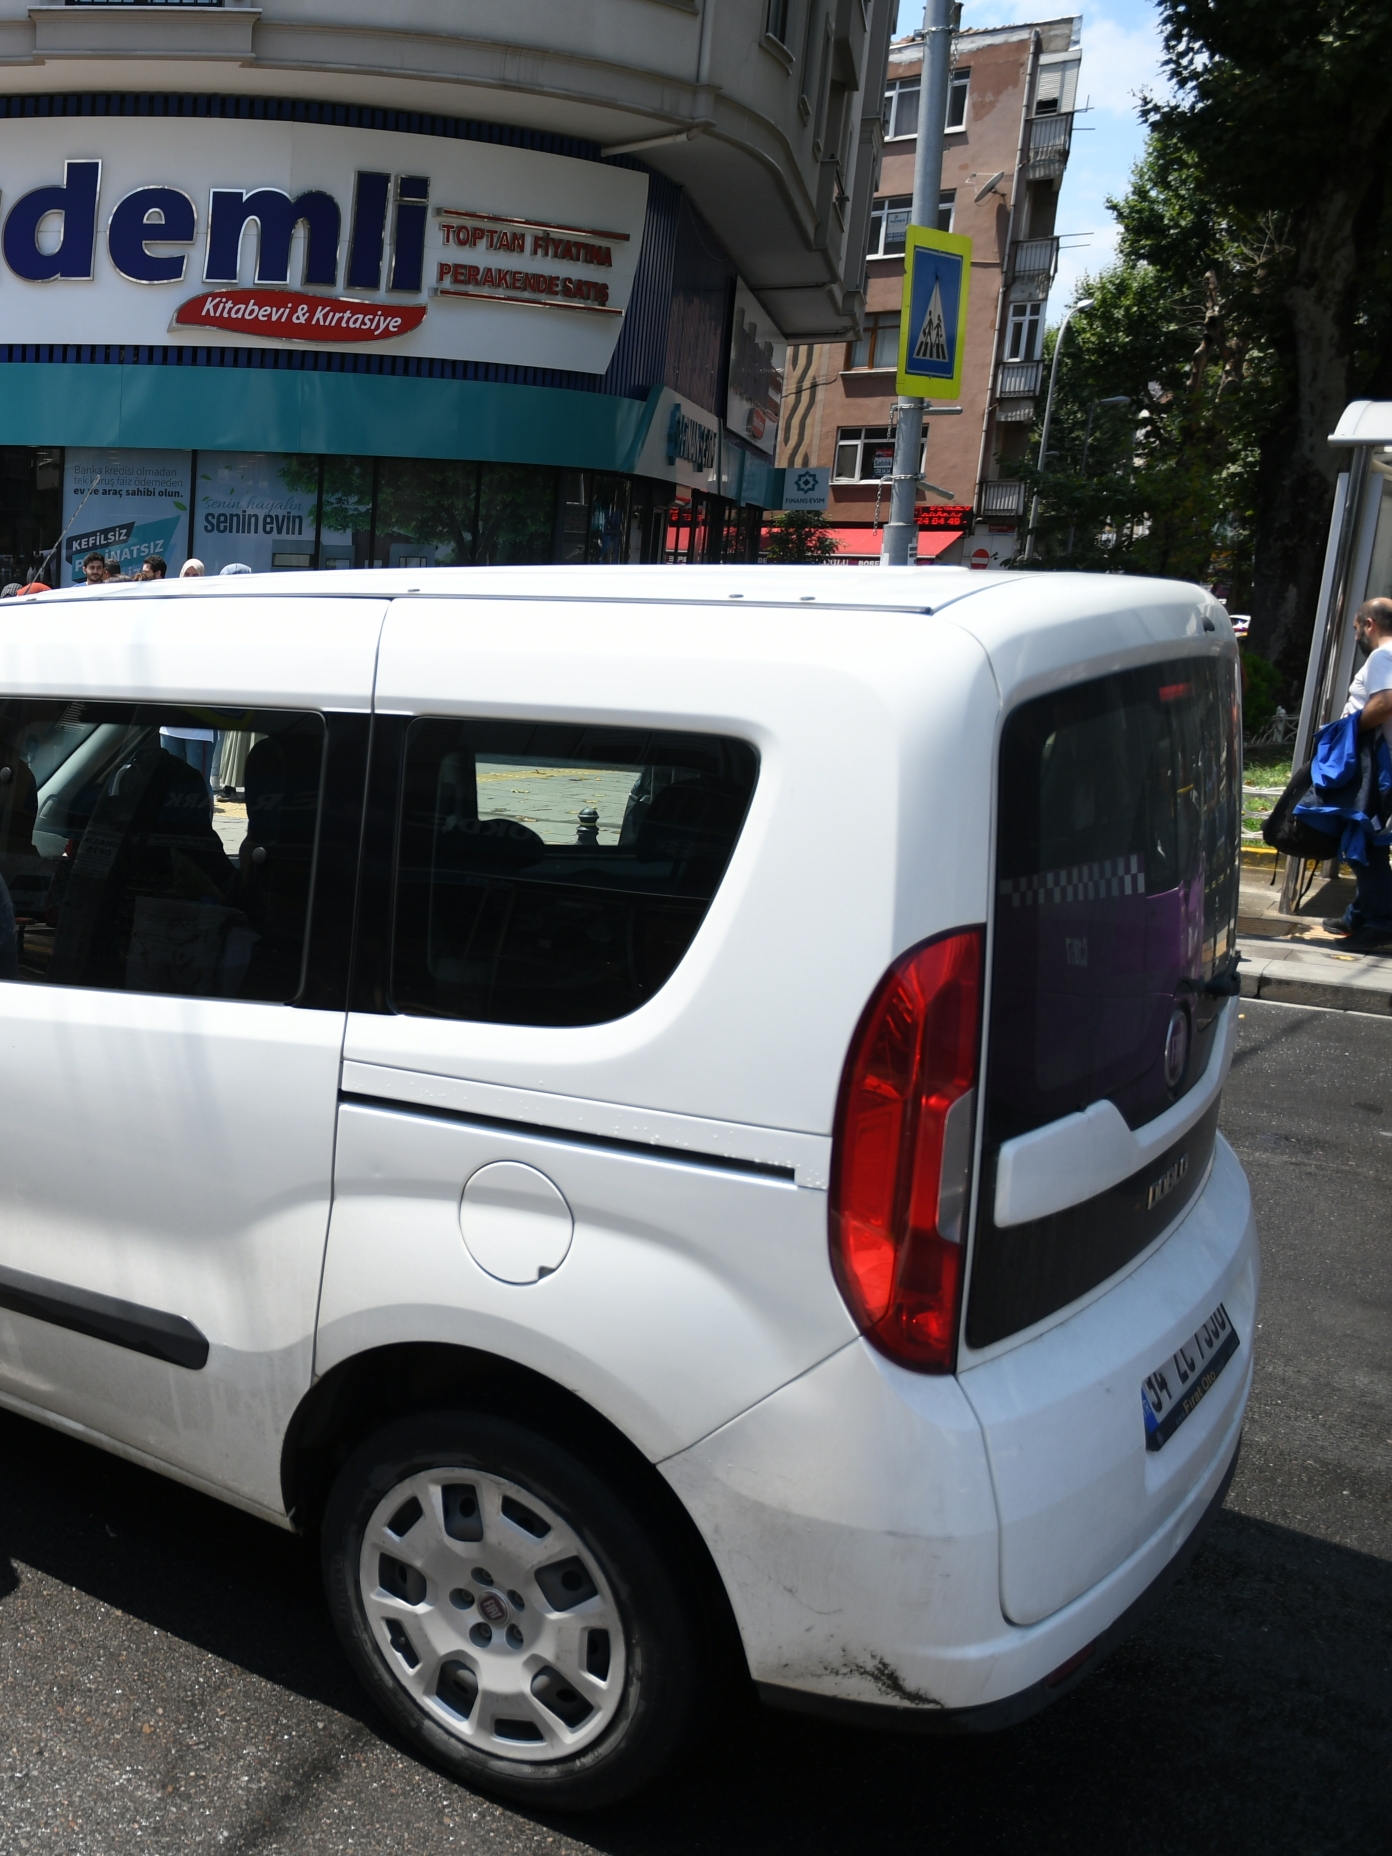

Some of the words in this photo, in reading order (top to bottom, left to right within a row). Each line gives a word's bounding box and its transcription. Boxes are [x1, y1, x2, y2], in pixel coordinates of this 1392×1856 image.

[441, 223, 525, 253] TOPTAN
[437, 262, 559, 296] PERAKENDE
[201, 296, 292, 323] Kitabevi
[292, 303, 310, 325] &
[311, 305, 402, 335] Kırtasiye
[74, 465, 103, 475] Banka
[104, 466, 134, 476] kredisi
[136, 467, 177, 477] olmadan
[74, 475, 88, 485] tek
[116, 476, 132, 487] faiz
[134, 477, 183, 488] ödemeden
[101, 488, 123, 498] araç
[125, 487, 156, 497] sahibi
[158, 488, 184, 498] olun.
[203, 509, 259, 534] senin
[262, 511, 303, 536] evin
[72, 527, 128, 552] KEFİLSİZ
[75, 539, 164, 572] PİNATSIZ
[1201, 1370, 1217, 1391] Oto
